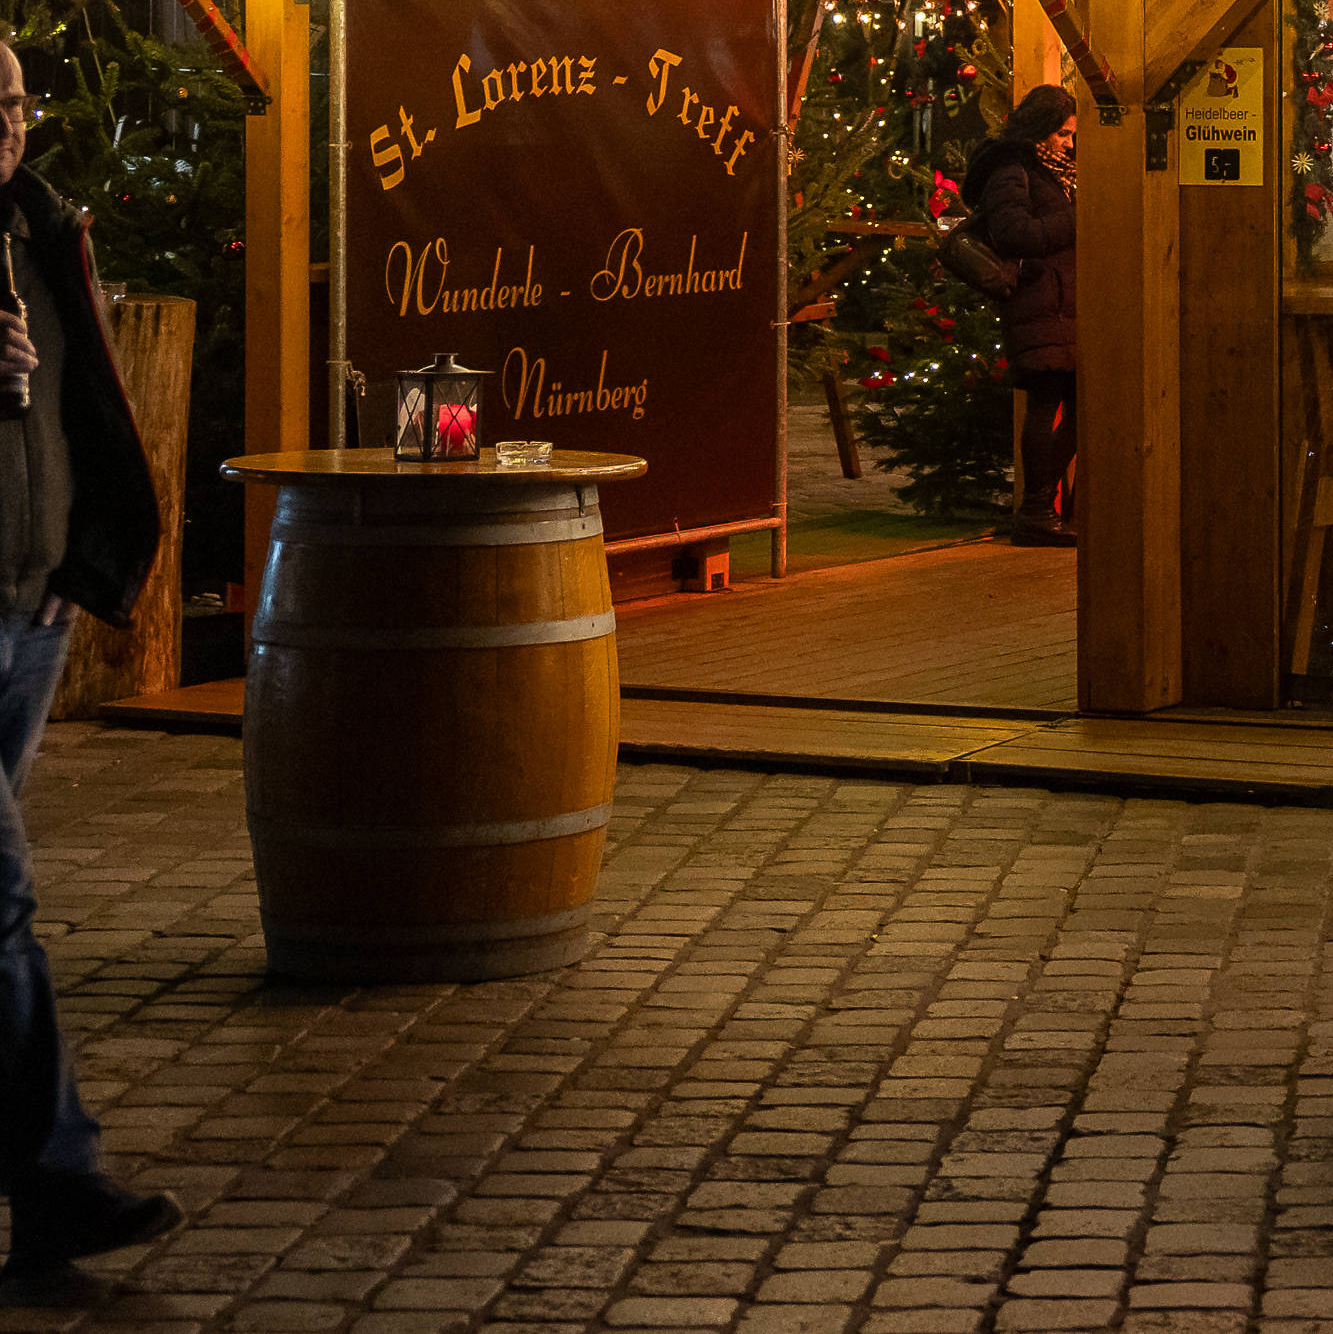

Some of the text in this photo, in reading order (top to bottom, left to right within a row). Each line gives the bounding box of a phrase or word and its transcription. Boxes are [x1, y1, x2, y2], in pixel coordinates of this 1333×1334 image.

[369, 105, 437, 191] St.
[452, 53, 598, 129] Lorenz
[646, 48, 756, 176] Treff
[1185, 107, 1249, 120] Heidelbeer
[1185, 125, 1257, 141] Glühwein
[385, 237, 543, 317] Wunderle
[590, 228, 748, 301] Bernhard
[502, 347, 648, 420] Nürnberg
